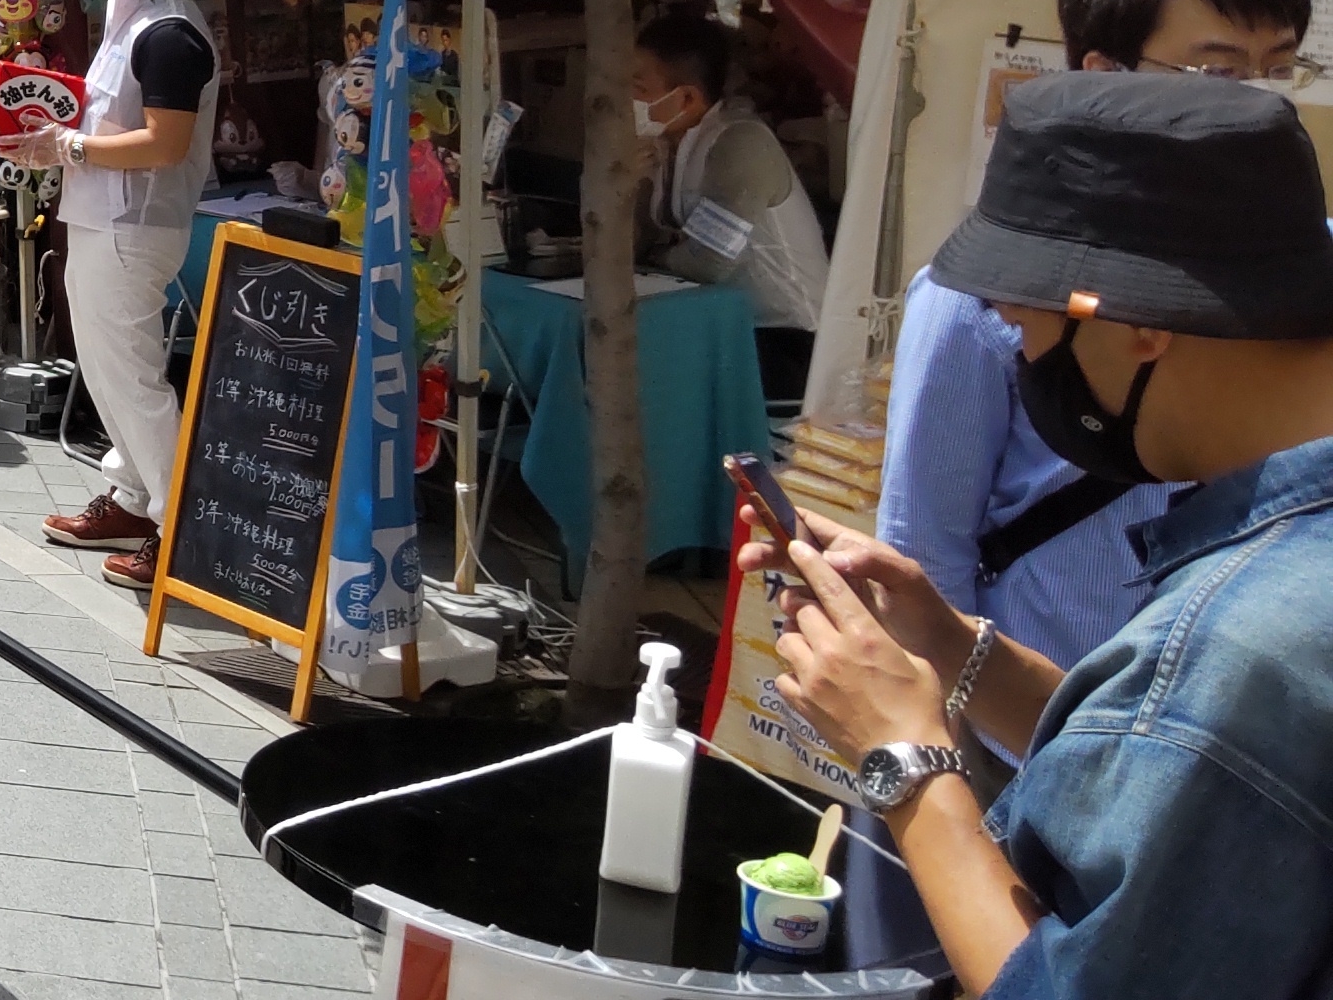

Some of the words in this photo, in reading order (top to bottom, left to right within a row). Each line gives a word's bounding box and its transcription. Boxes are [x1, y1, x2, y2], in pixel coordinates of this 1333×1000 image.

[237, 277, 329, 337] くじ引き
[215, 376, 241, 403] 1等
[247, 383, 325, 423] 沖縄料理
[204, 441, 232, 464] 2等
[194, 497, 224, 524] 3等
[223, 510, 295, 556] 沖縄料理
